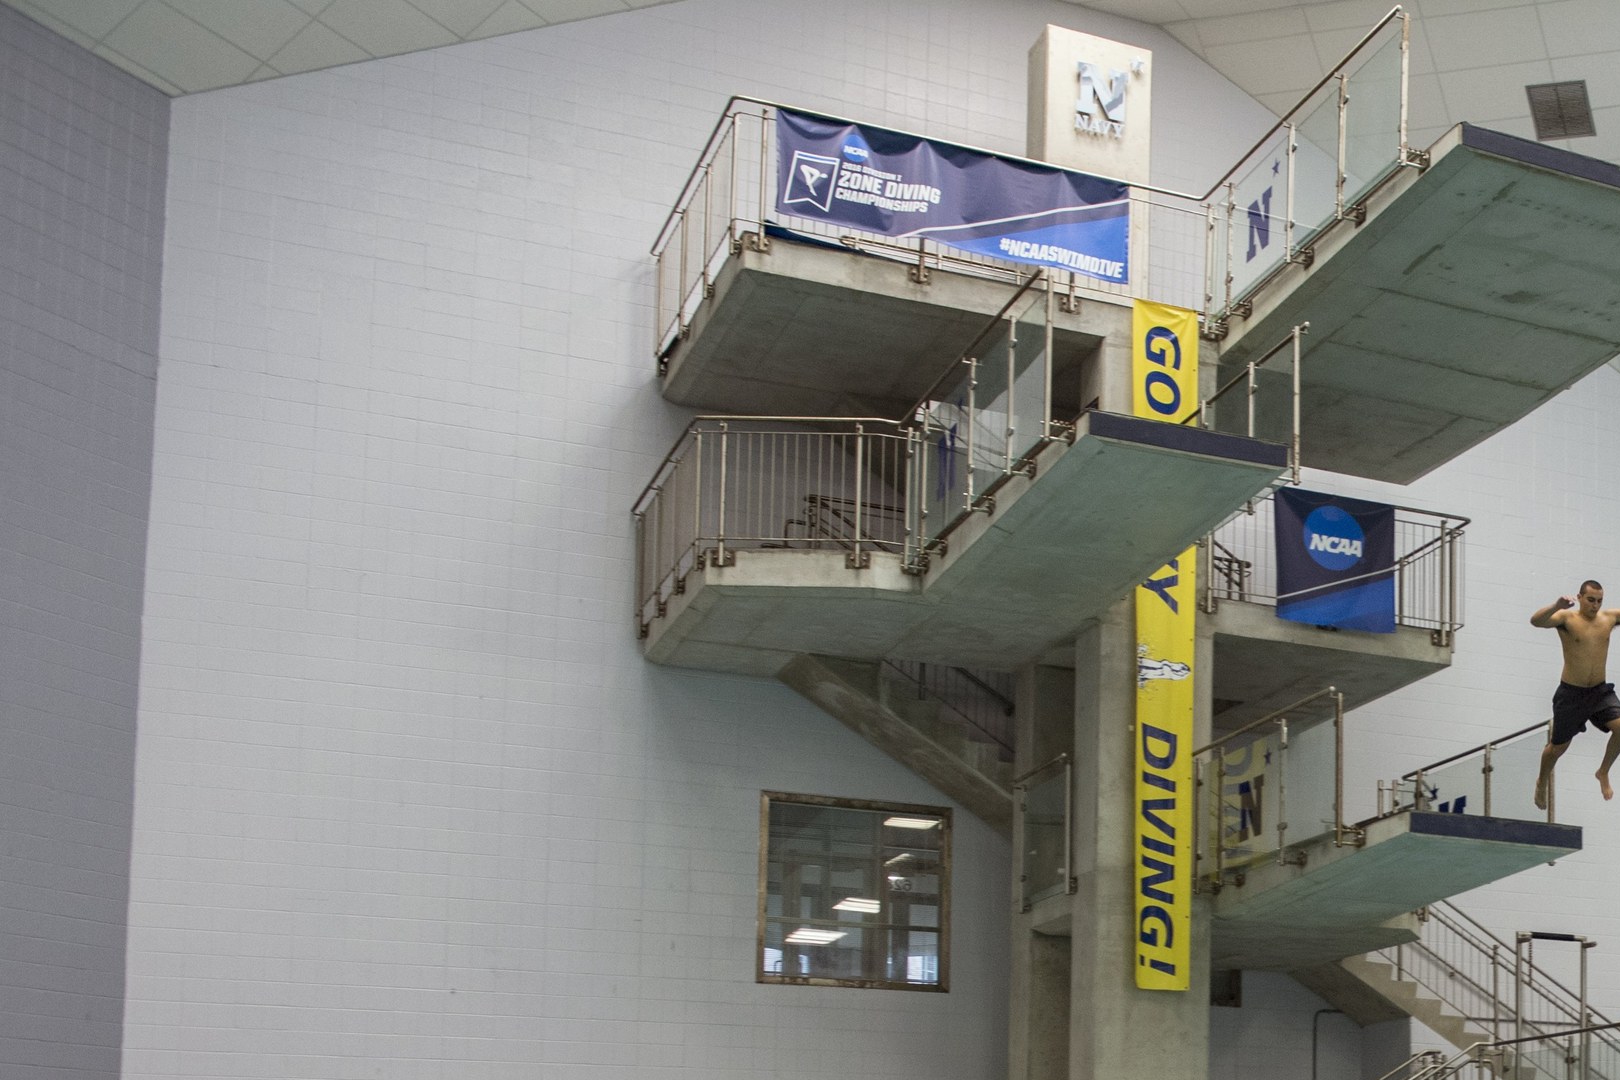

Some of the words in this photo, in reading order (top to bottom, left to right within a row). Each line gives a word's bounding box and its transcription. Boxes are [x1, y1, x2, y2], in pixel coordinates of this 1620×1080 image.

[1073, 114, 1125, 138] NAVY
[835, 187, 928, 213] CHAMPIONSHIPS
[838, 170, 883, 194] ZONE
[884, 181, 941, 204] DIVING
[1000, 237, 1124, 278] #NCAASWIMDIVE
[1144, 325, 1181, 415] GO
[1310, 533, 1362, 558] NCAA
[1139, 722, 1178, 976] DIVING!
